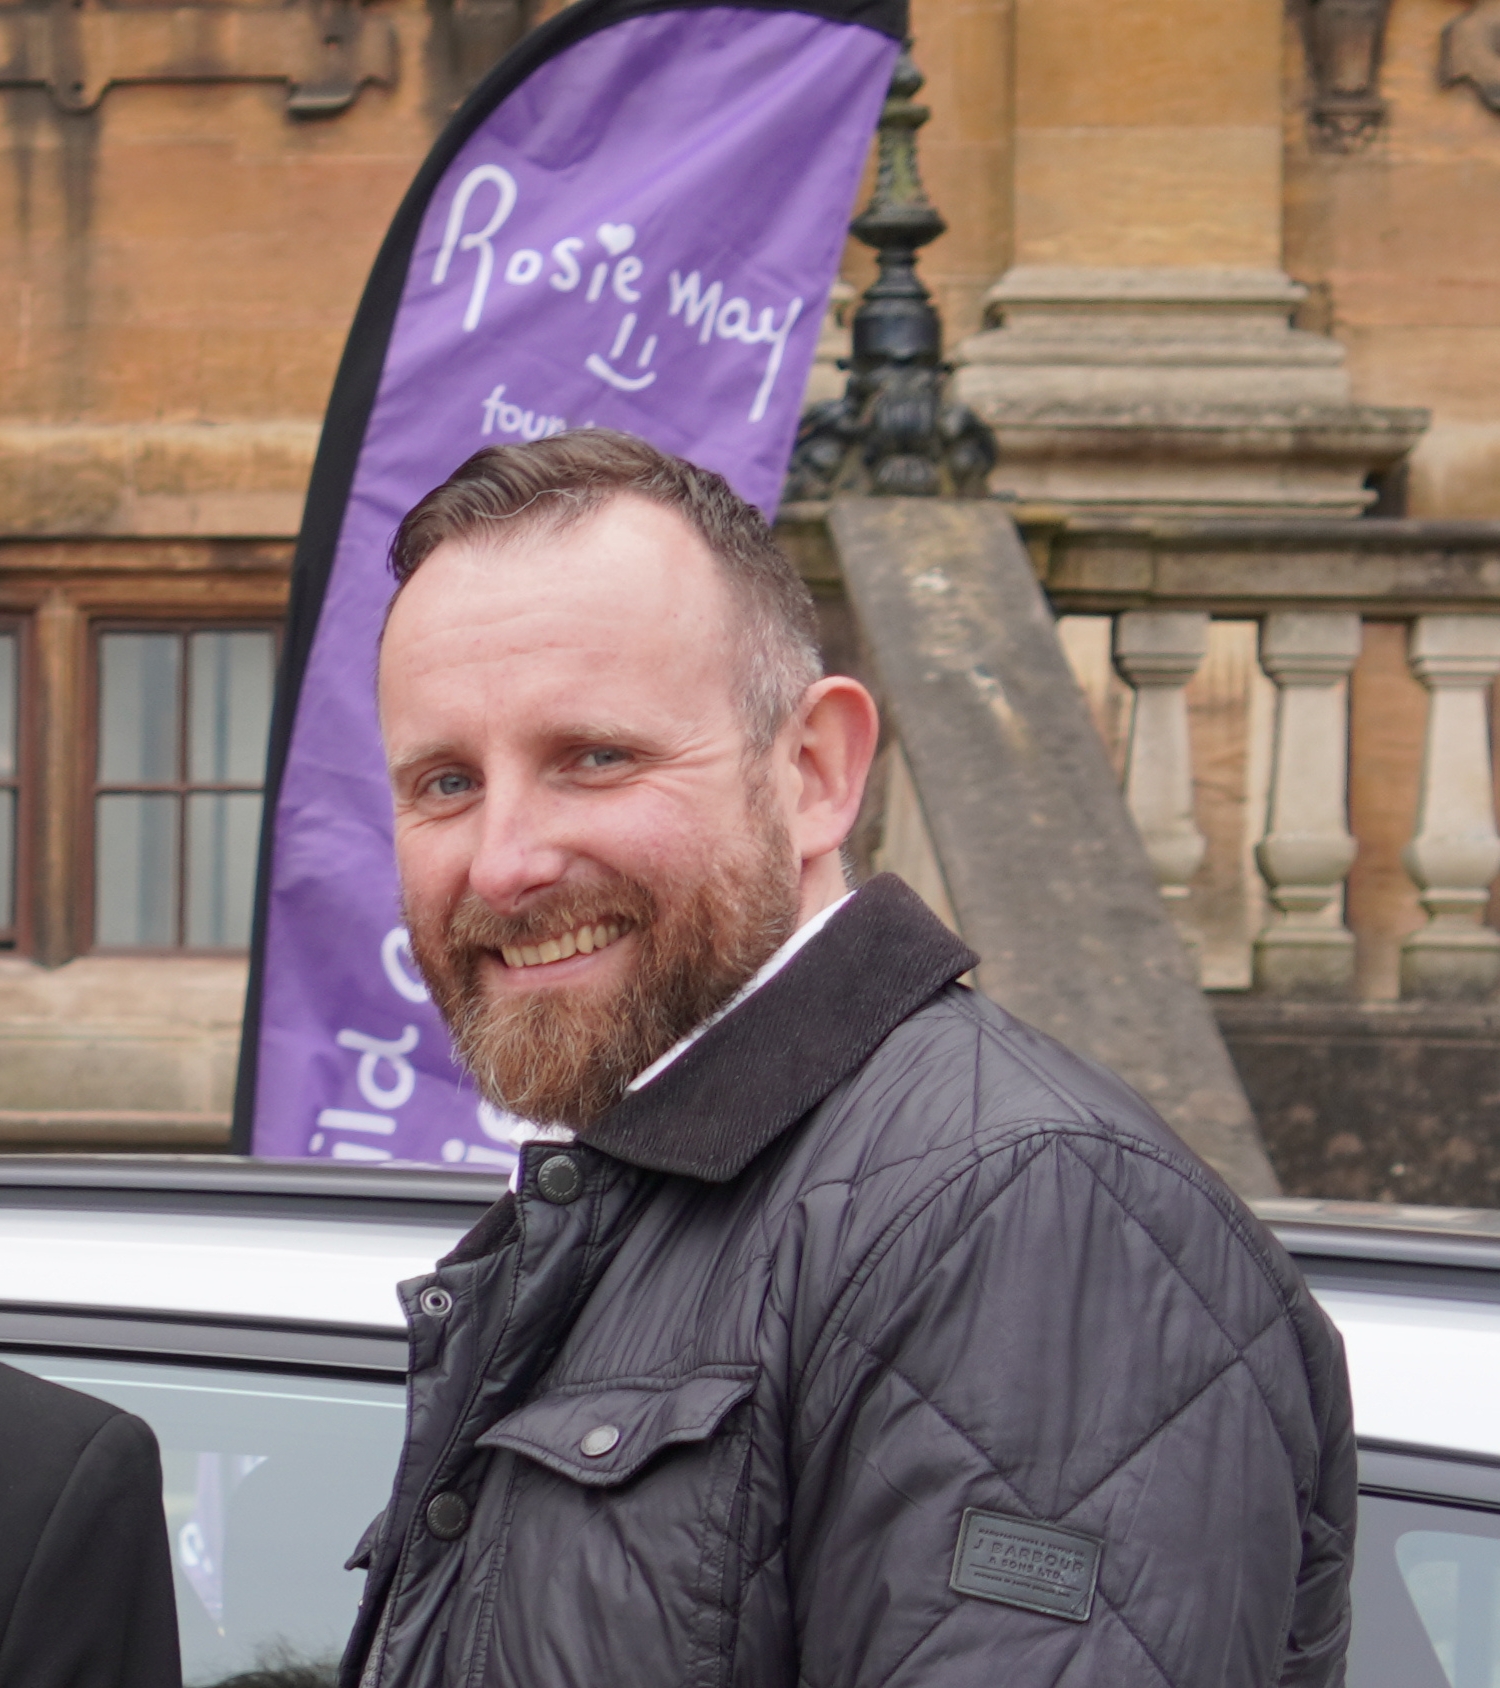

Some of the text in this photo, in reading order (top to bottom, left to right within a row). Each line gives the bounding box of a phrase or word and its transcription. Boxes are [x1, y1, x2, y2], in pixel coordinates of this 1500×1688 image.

[431, 164, 643, 332] Rosie
[991, 1541, 1085, 1574] BARBOUR
[1001, 1558, 1034, 1574] SONS
